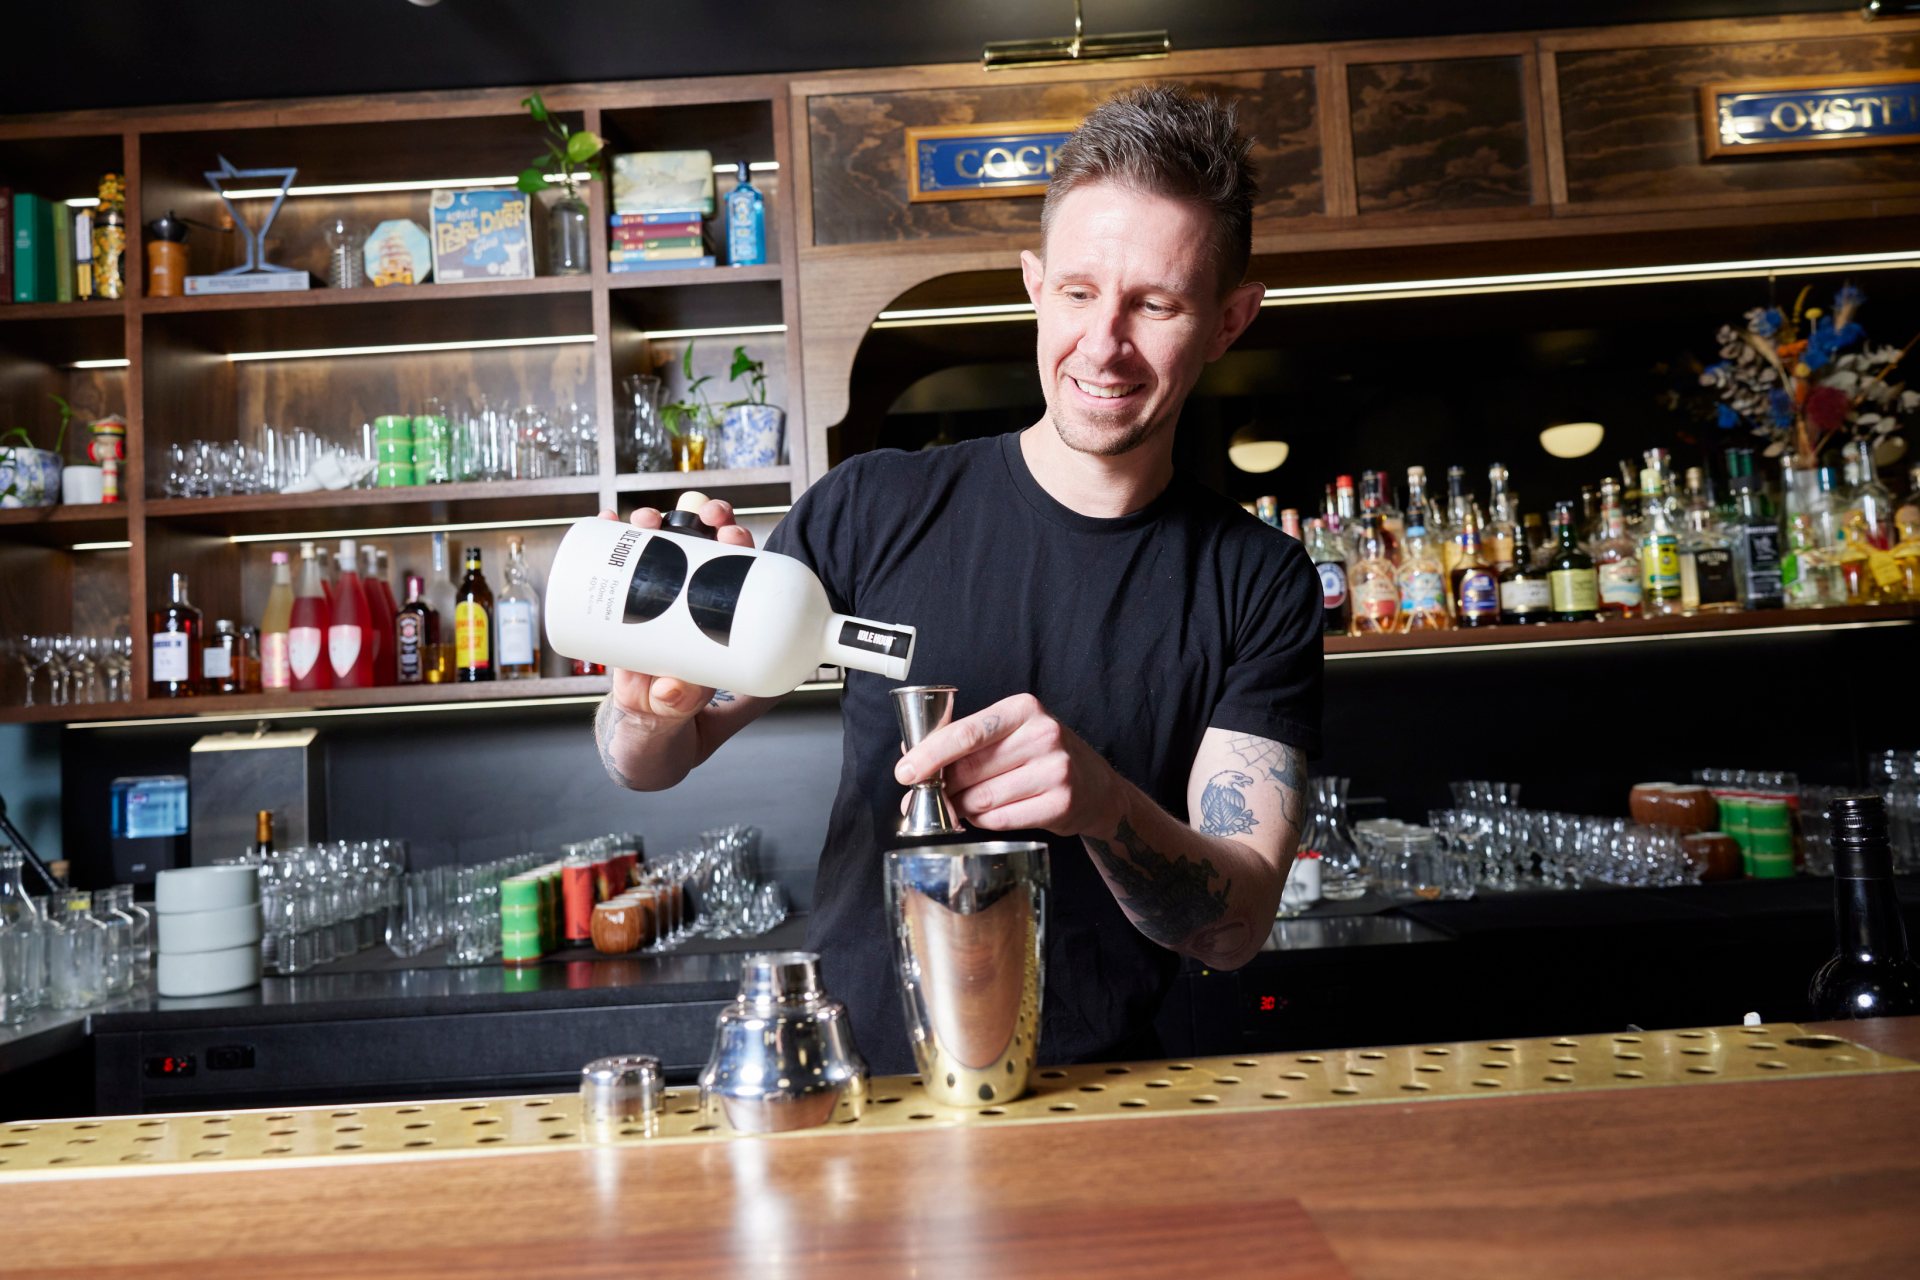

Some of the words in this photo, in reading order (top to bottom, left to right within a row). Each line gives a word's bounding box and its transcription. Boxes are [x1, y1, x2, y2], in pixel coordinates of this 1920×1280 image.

[608, 542, 633, 567] HOUR
[857, 629, 874, 643] IDLE
[873, 634, 893, 647] HOUR
